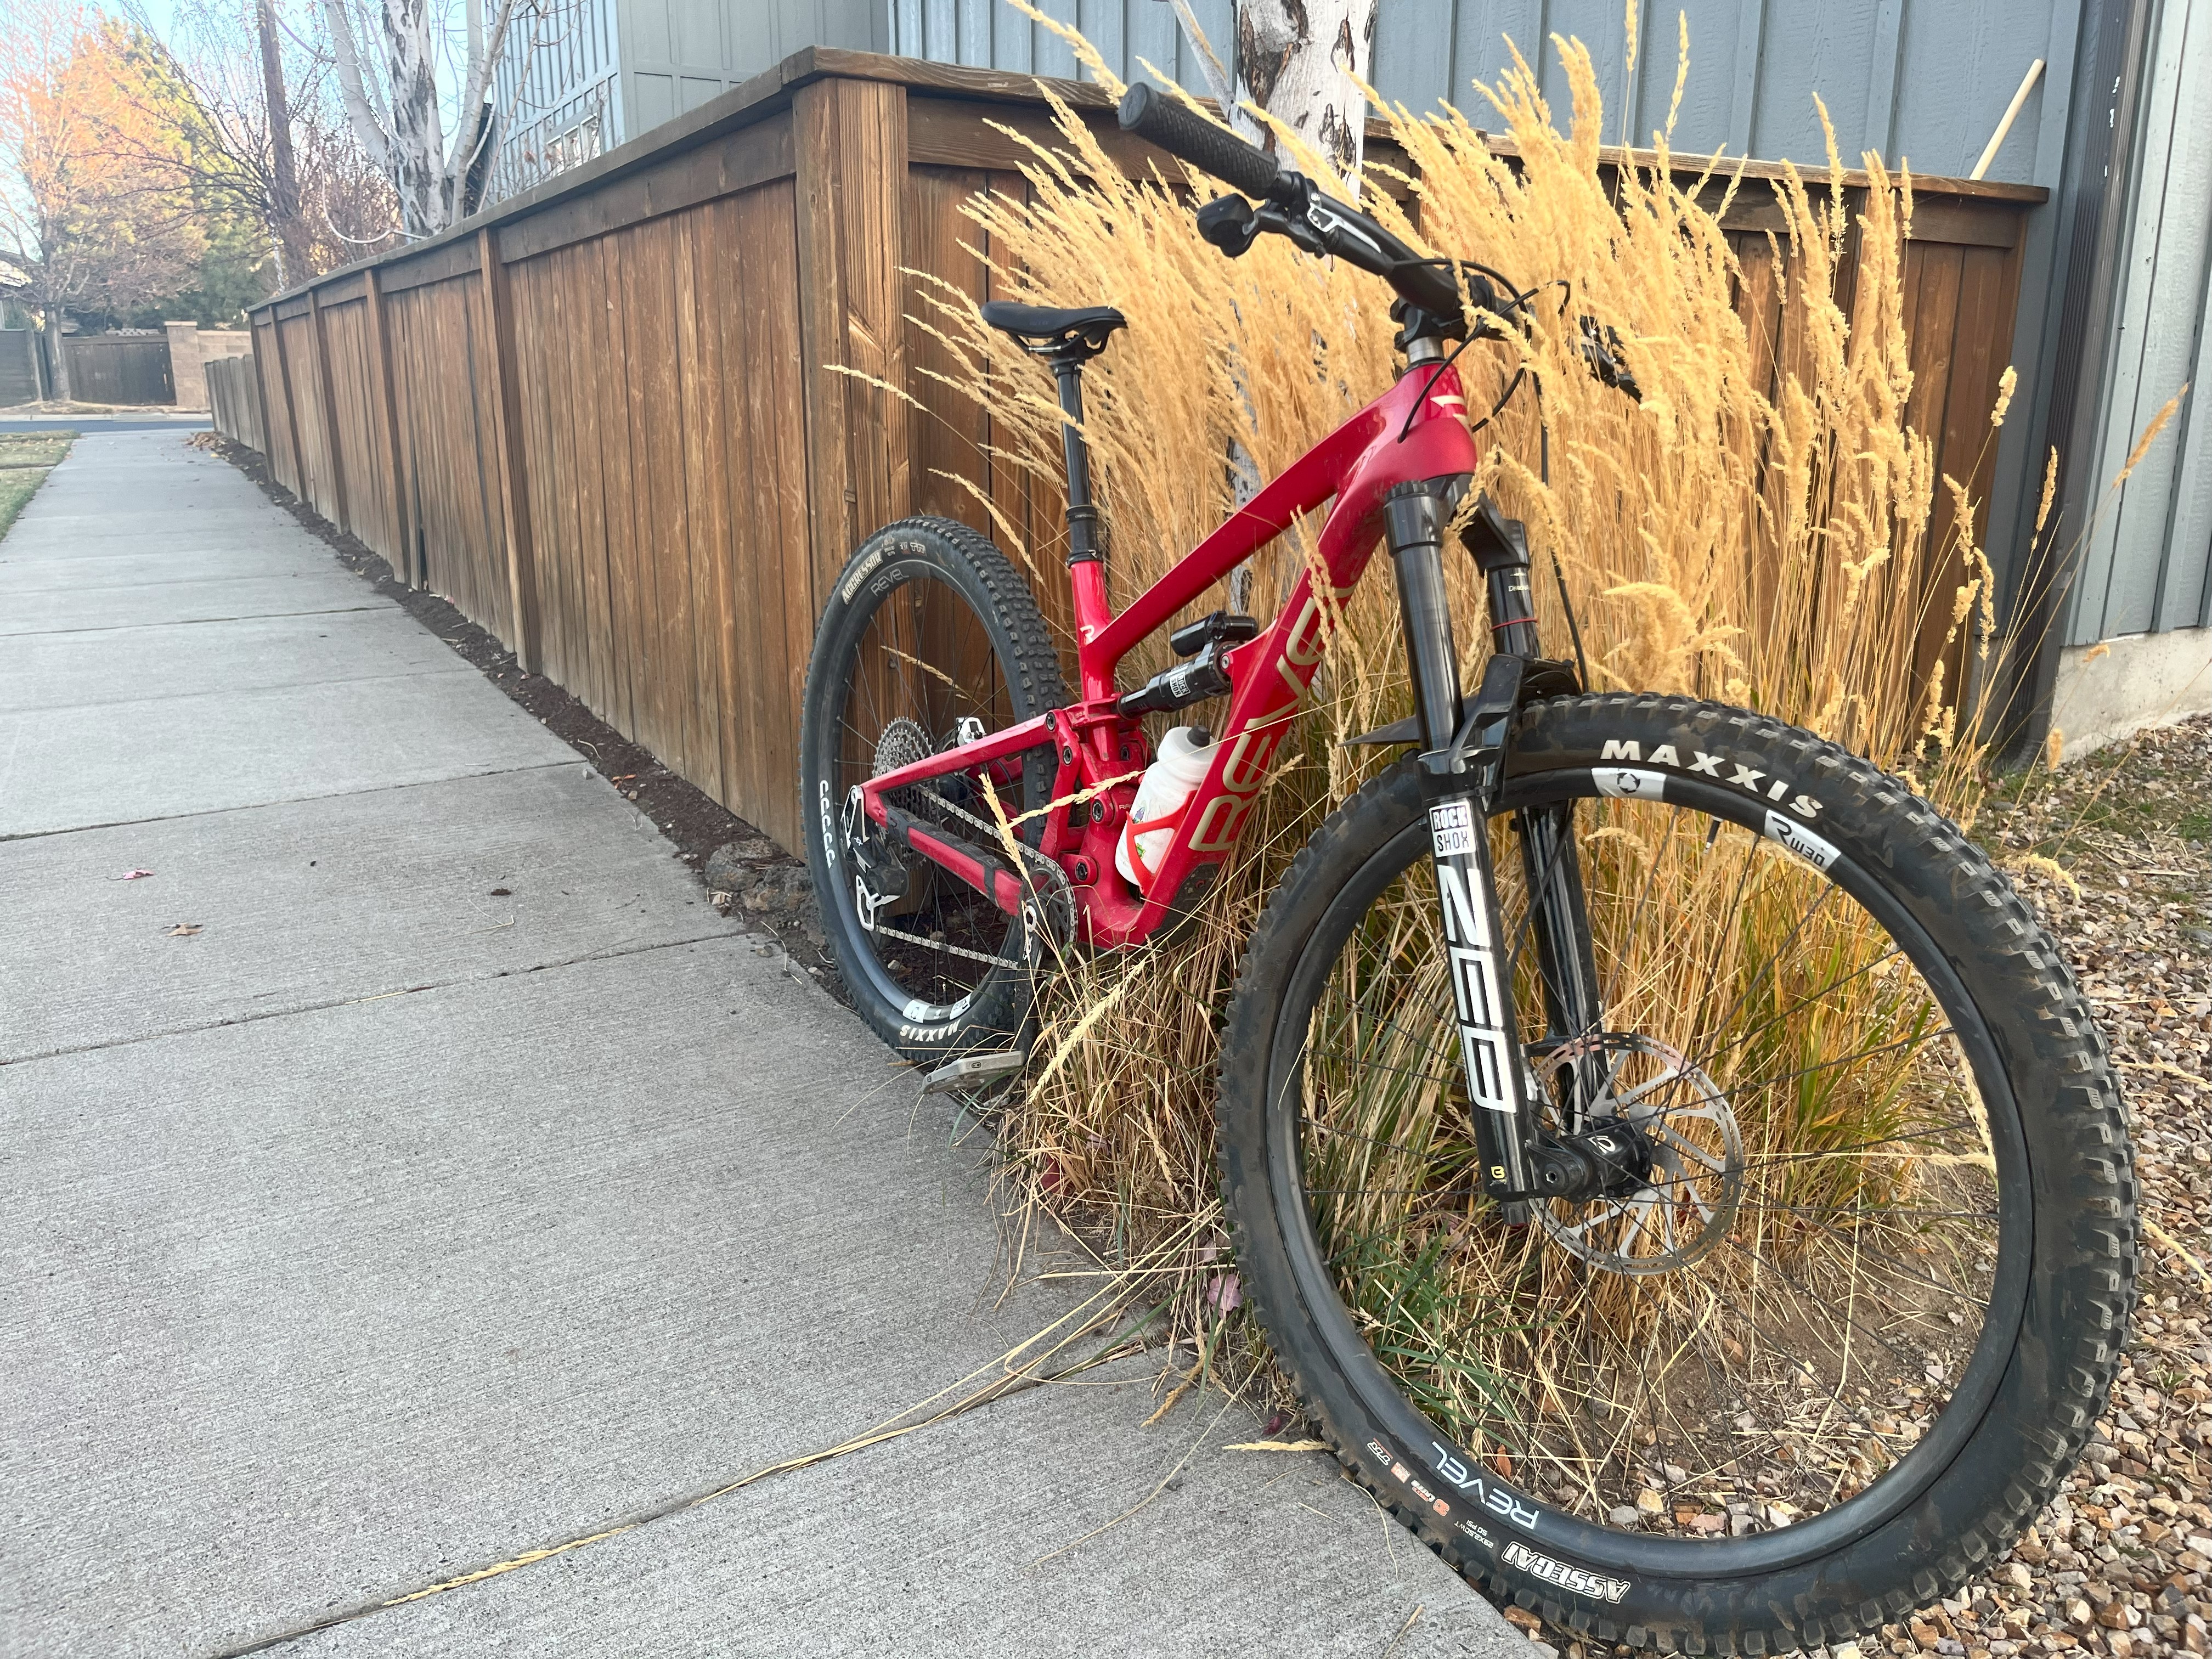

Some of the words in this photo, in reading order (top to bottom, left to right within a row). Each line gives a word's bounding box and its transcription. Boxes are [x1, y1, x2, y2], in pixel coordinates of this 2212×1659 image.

[841, 549, 883, 605] AGGRESSOR
[870, 568, 910, 597] REVEL
[1171, 678, 1181, 696] SHOX
[1177, 675, 1188, 694] ROCK
[1600, 739, 1824, 818] MAXXIS
[1432, 806, 1469, 830] ROCK
[1437, 831, 1469, 851] SHOX
[1437, 865, 1517, 1113] ZEB
[899, 1018, 961, 1042] MAXXIS
[1432, 1441, 1540, 1530] REVEL
[1465, 1519, 1478, 1531] PSI
[1477, 1526, 1488, 1537] 50
[1501, 1541, 1631, 1604] ASSEGAI
